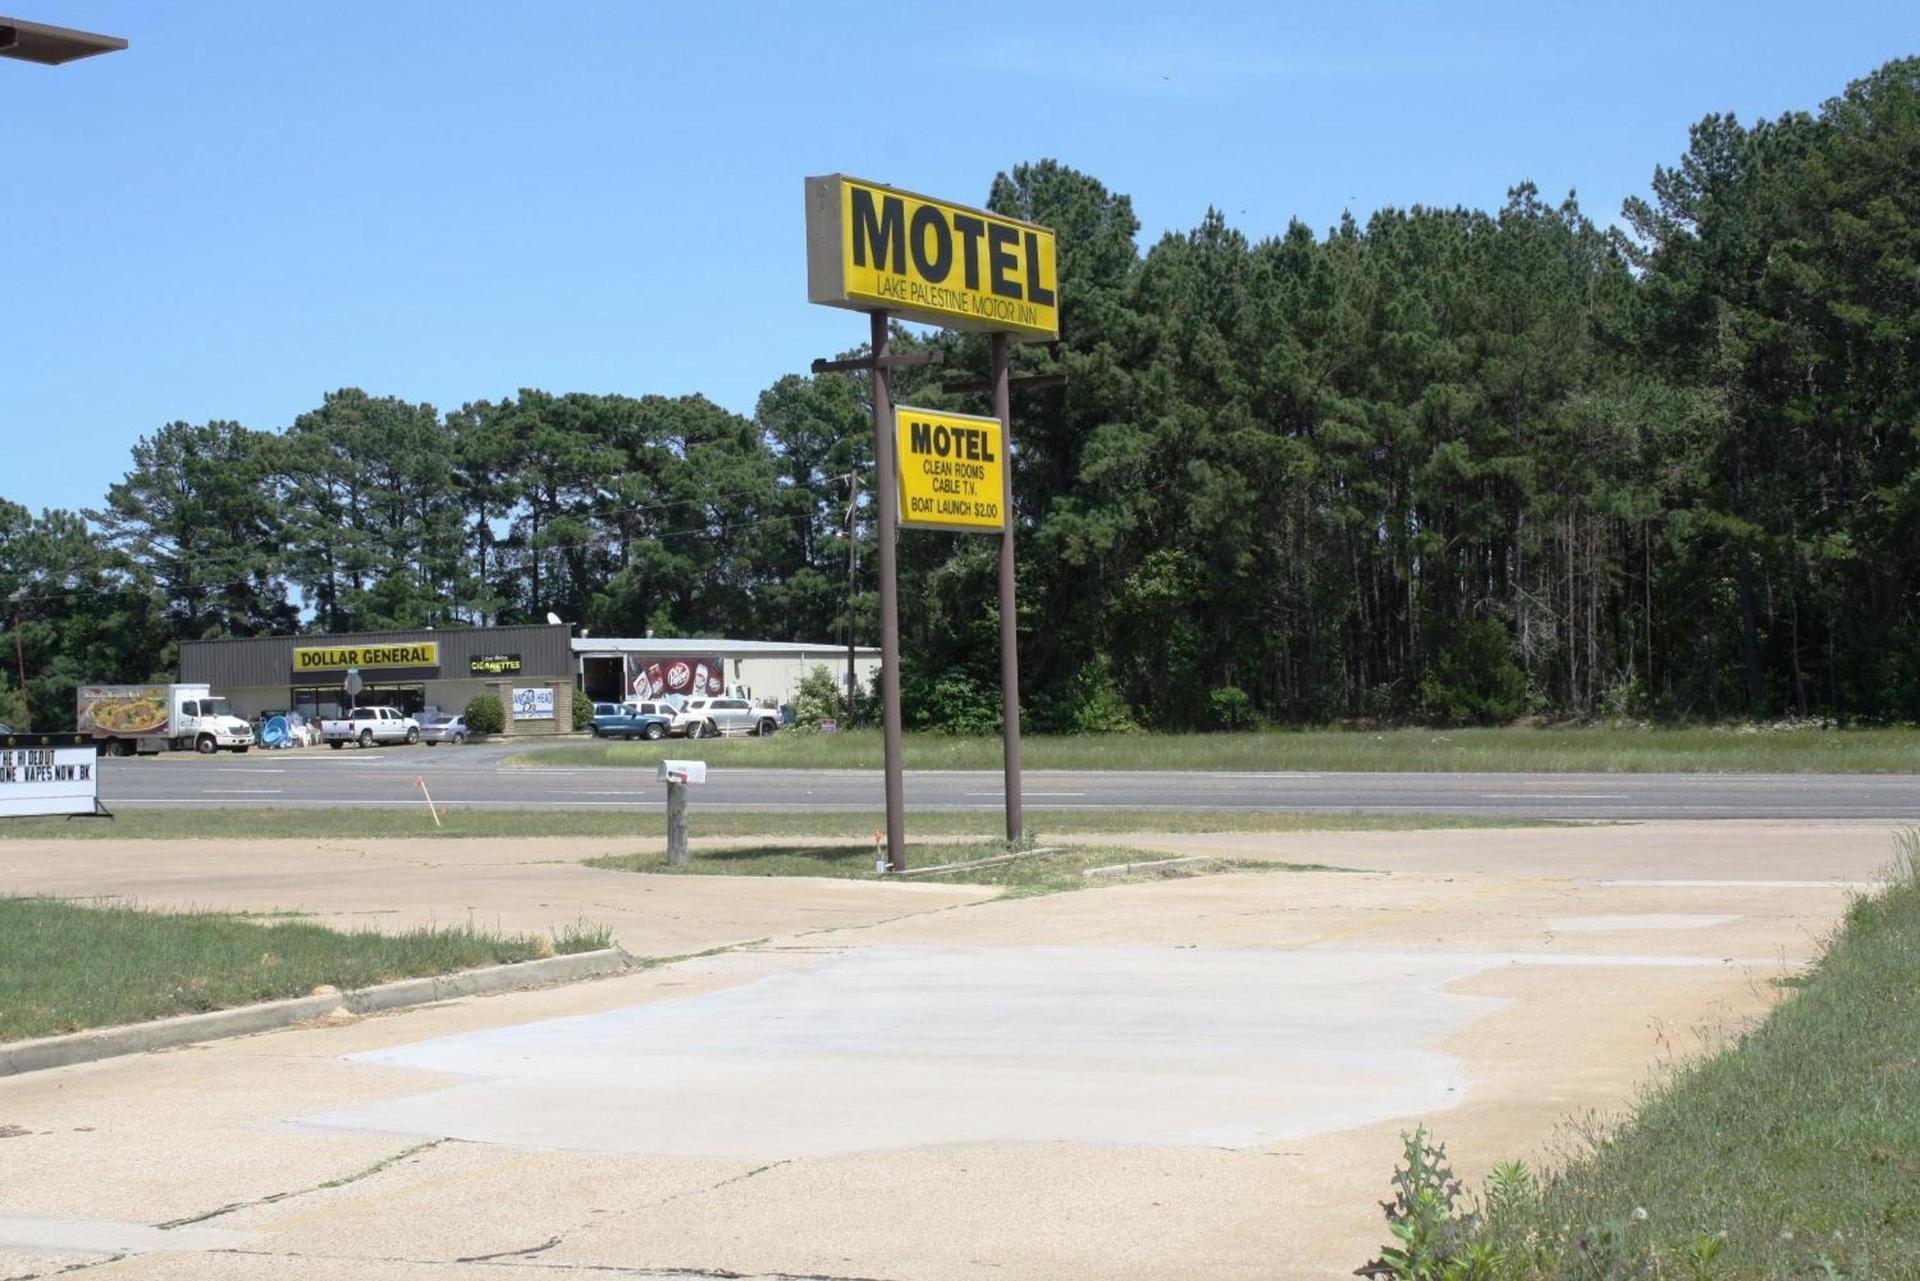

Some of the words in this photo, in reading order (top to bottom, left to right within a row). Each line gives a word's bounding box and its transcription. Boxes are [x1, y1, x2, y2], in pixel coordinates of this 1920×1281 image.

[851, 187, 1055, 308] MOTEL
[877, 276, 907, 301] LAKE
[910, 281, 968, 313] PALESTINE
[972, 295, 1015, 320] MOTOR
[1018, 305, 1037, 326] INN
[911, 422, 995, 463] MOTEL
[923, 459, 952, 476] CLEAN
[954, 463, 985, 480] ROOMS
[932, 477, 961, 494] CABLE
[962, 480, 978, 497] T.V.
[911, 497, 935, 513] BOAT
[937, 499, 971, 516] LAUNCH
[974, 502, 998, 519] $2.00
[301, 650, 359, 667] DOLLAR
[363, 647, 430, 664] GENERAL
[0, 750, 13, 766] HE
